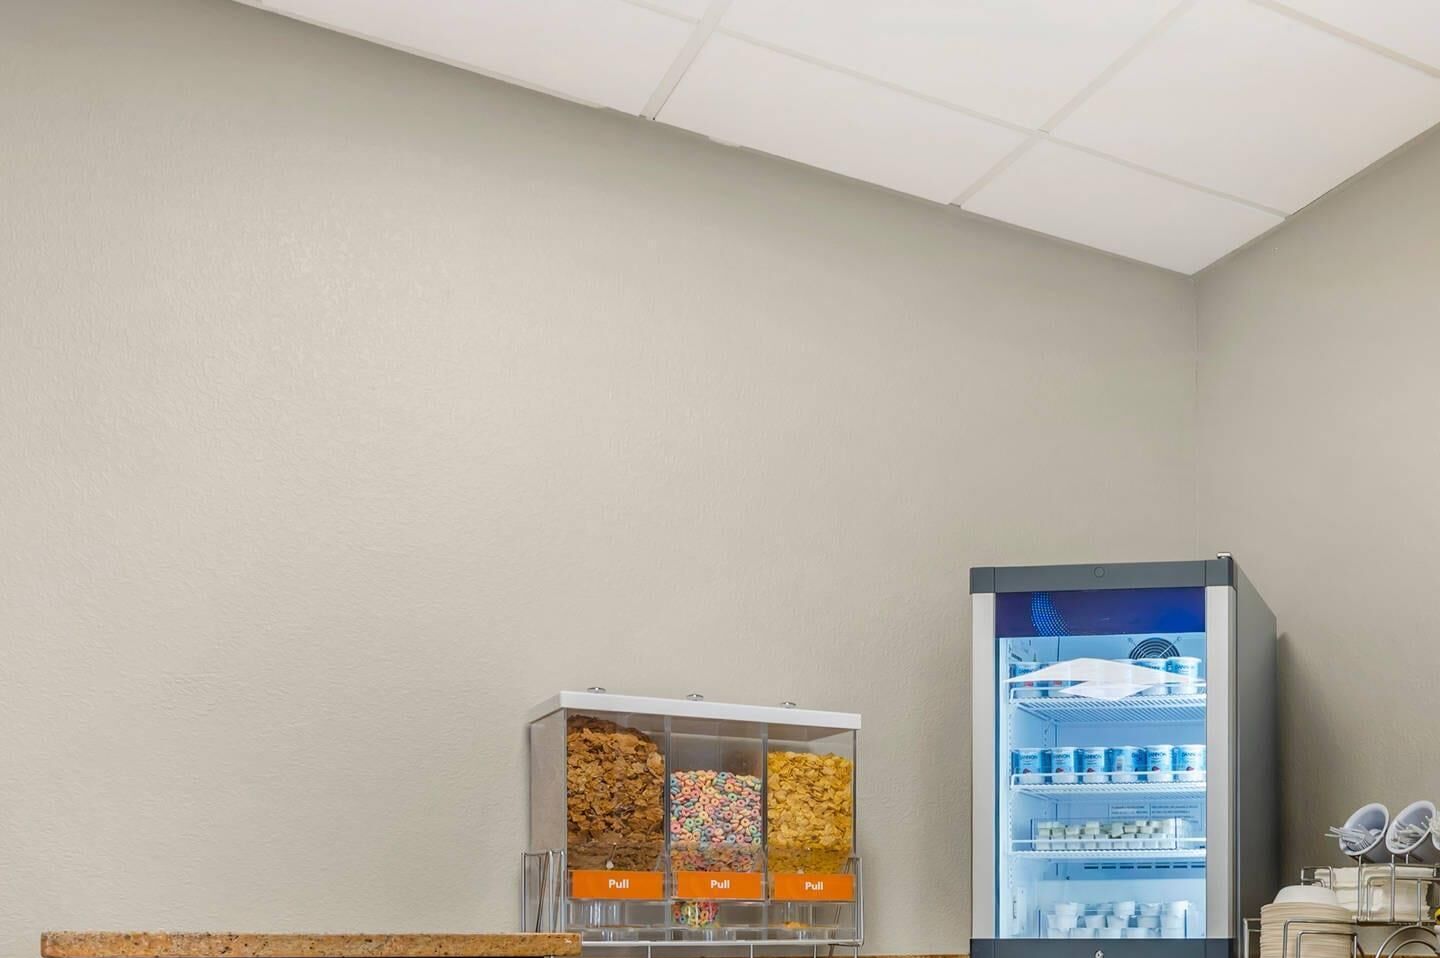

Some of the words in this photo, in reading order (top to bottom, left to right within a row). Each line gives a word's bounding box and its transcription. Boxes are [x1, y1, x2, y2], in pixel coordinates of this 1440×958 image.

[608, 879, 629, 889] Pull
[710, 879, 730, 889] Pull
[804, 881, 824, 891] Pull
